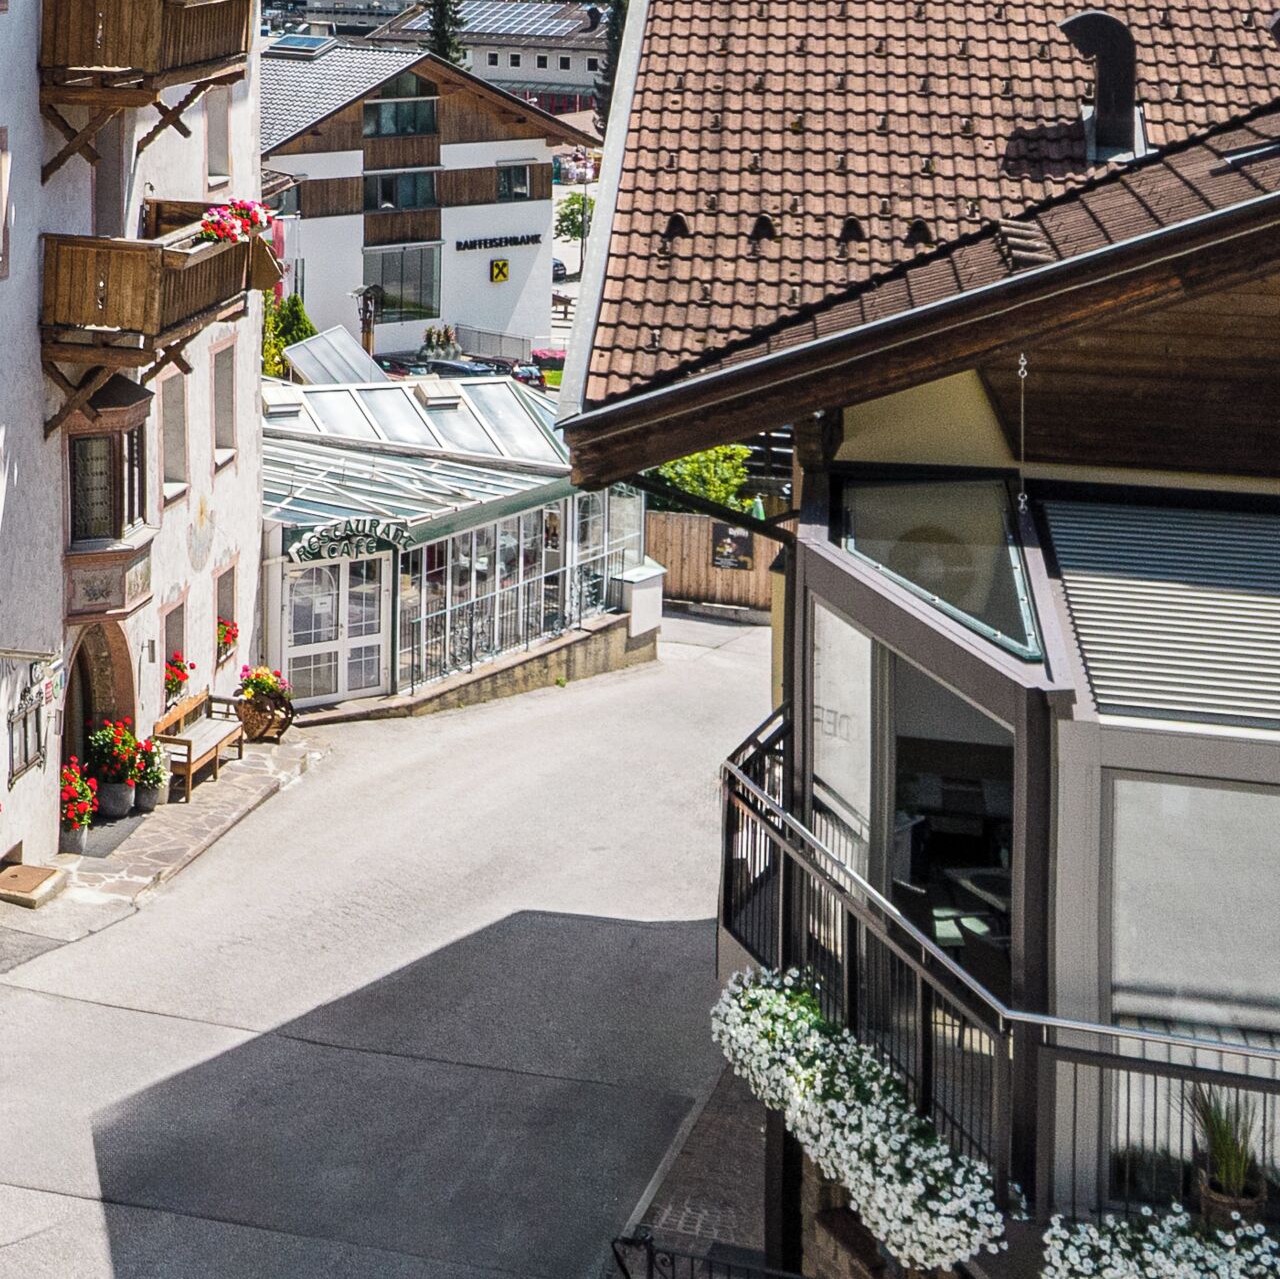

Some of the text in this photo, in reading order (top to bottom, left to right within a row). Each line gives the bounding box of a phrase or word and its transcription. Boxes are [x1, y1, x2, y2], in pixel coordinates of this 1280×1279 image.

[456, 234, 542, 251] RAIFFEISENBANK
[290, 518, 418, 564] RESTAURANT
[326, 537, 378, 560] CAFE
